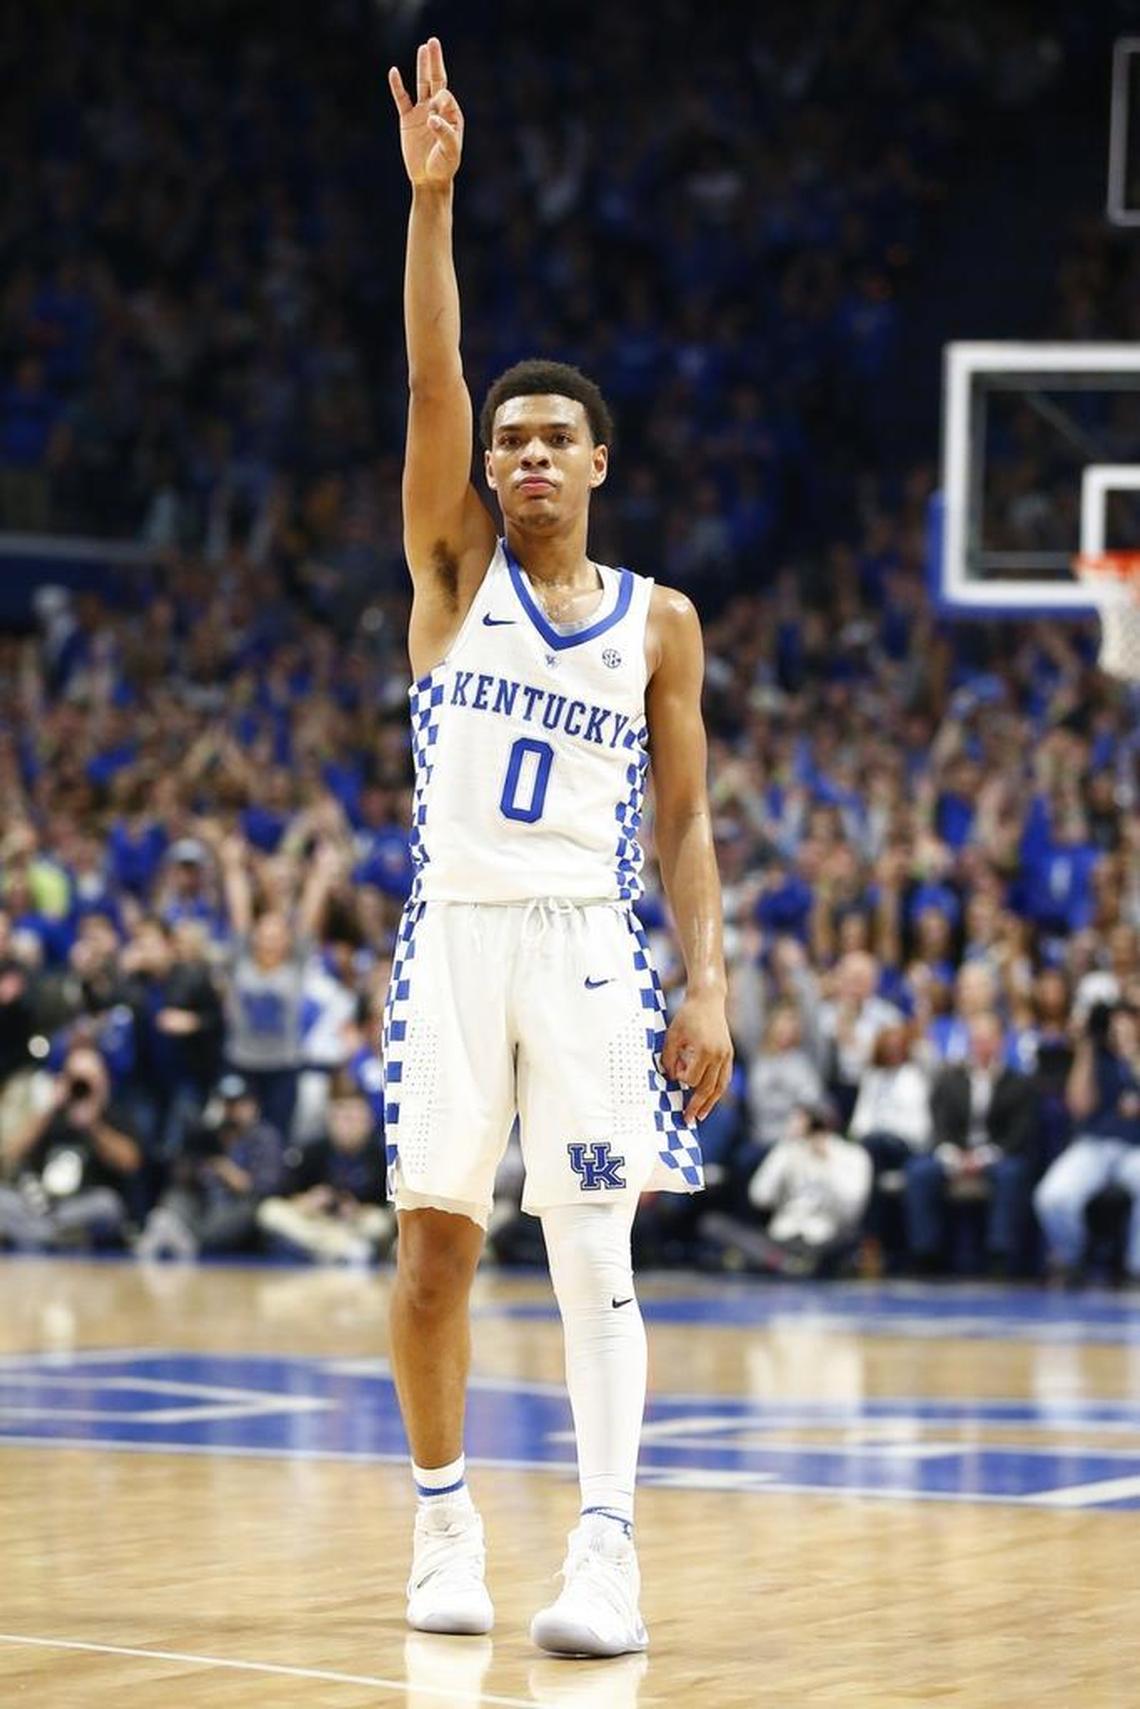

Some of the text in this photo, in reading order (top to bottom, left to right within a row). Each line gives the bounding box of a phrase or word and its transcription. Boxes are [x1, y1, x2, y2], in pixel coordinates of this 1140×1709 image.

[450, 671, 629, 748] KENTUCKY
[500, 737, 554, 823] 0
[567, 1142, 626, 1190] UK
